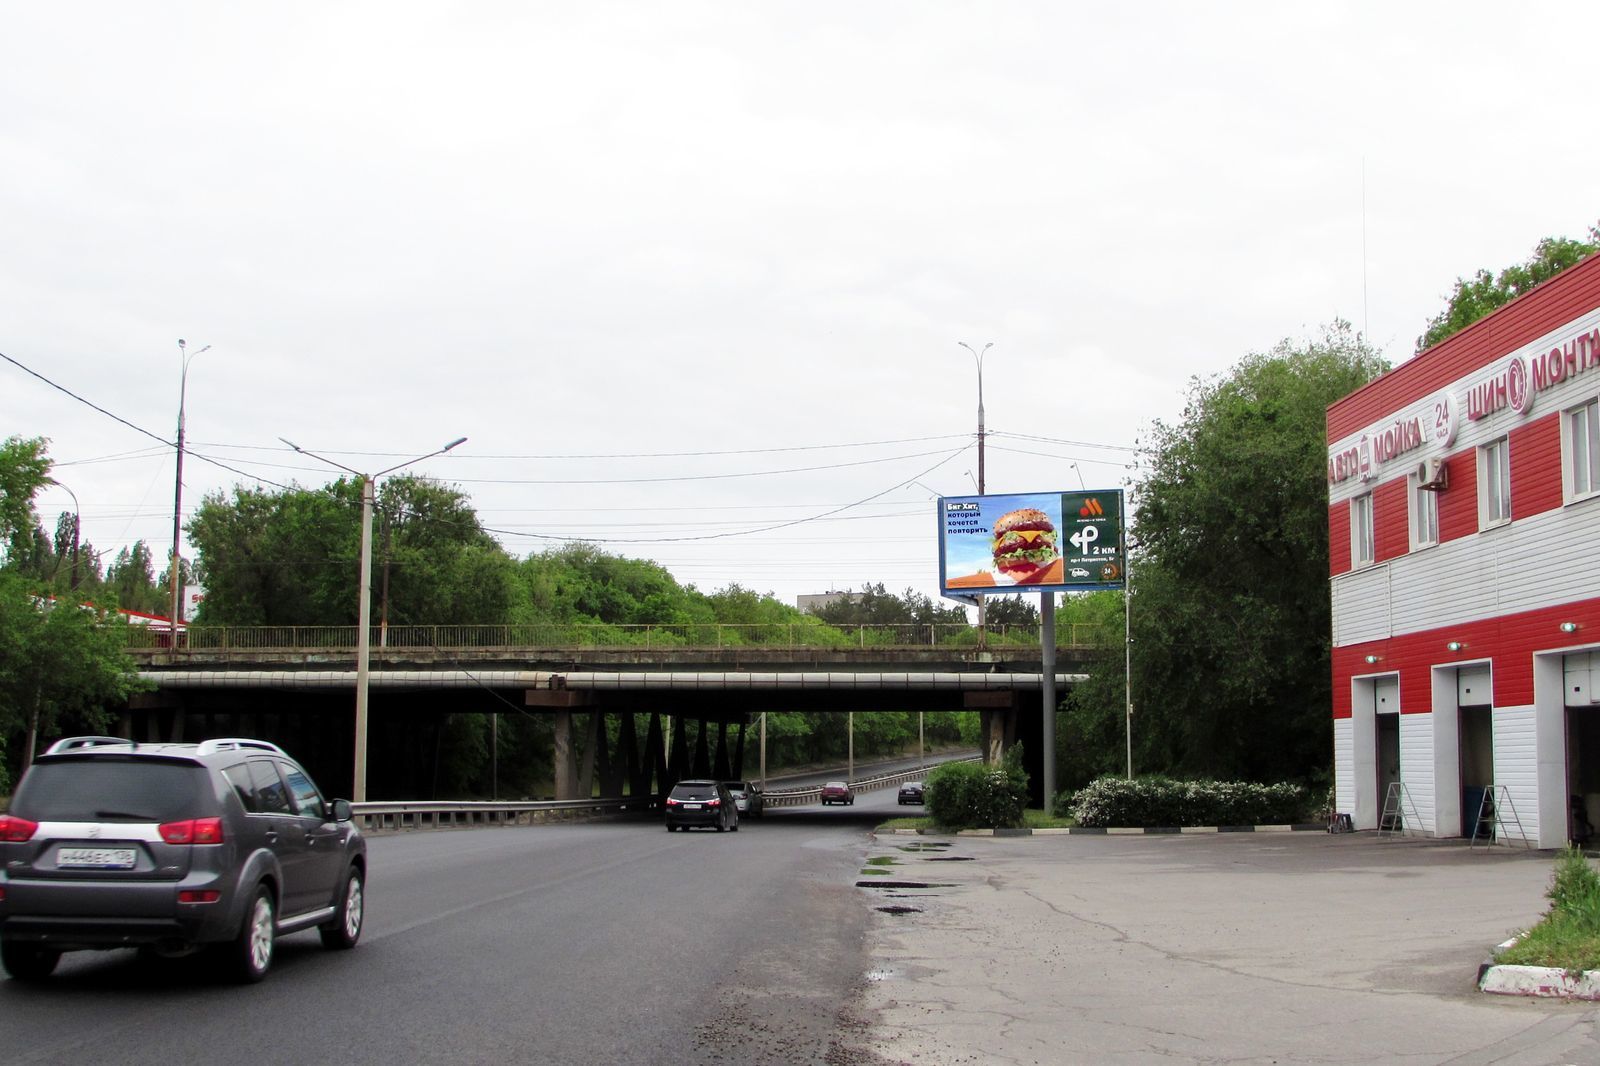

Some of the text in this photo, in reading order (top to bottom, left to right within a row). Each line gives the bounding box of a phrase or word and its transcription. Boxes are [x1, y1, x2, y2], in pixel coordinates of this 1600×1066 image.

[1435, 399, 1449, 428] 24
[1374, 416, 1421, 464] МОЙКА
[1093, 546, 1100, 555] 2
